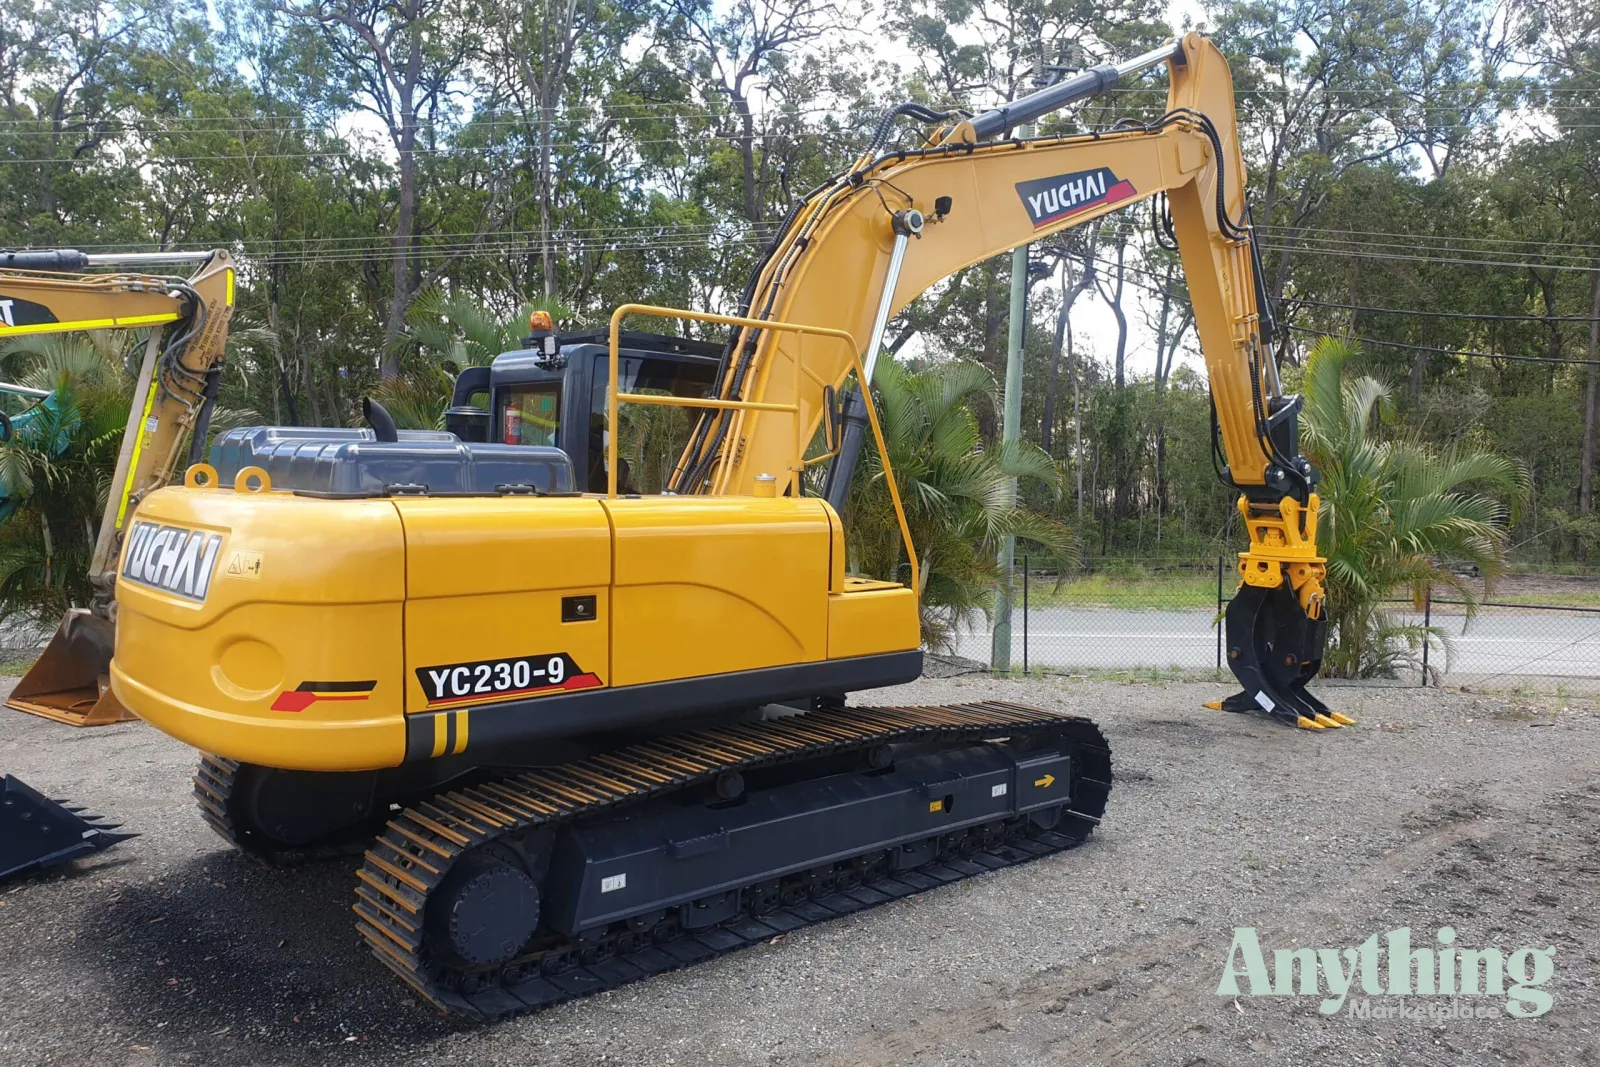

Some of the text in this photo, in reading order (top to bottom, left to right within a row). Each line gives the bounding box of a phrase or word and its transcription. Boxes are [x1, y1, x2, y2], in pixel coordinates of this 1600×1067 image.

[1028, 171, 1106, 218] YUCHAI
[123, 524, 220, 597] YUCHAI
[428, 657, 565, 697] YC230-9
